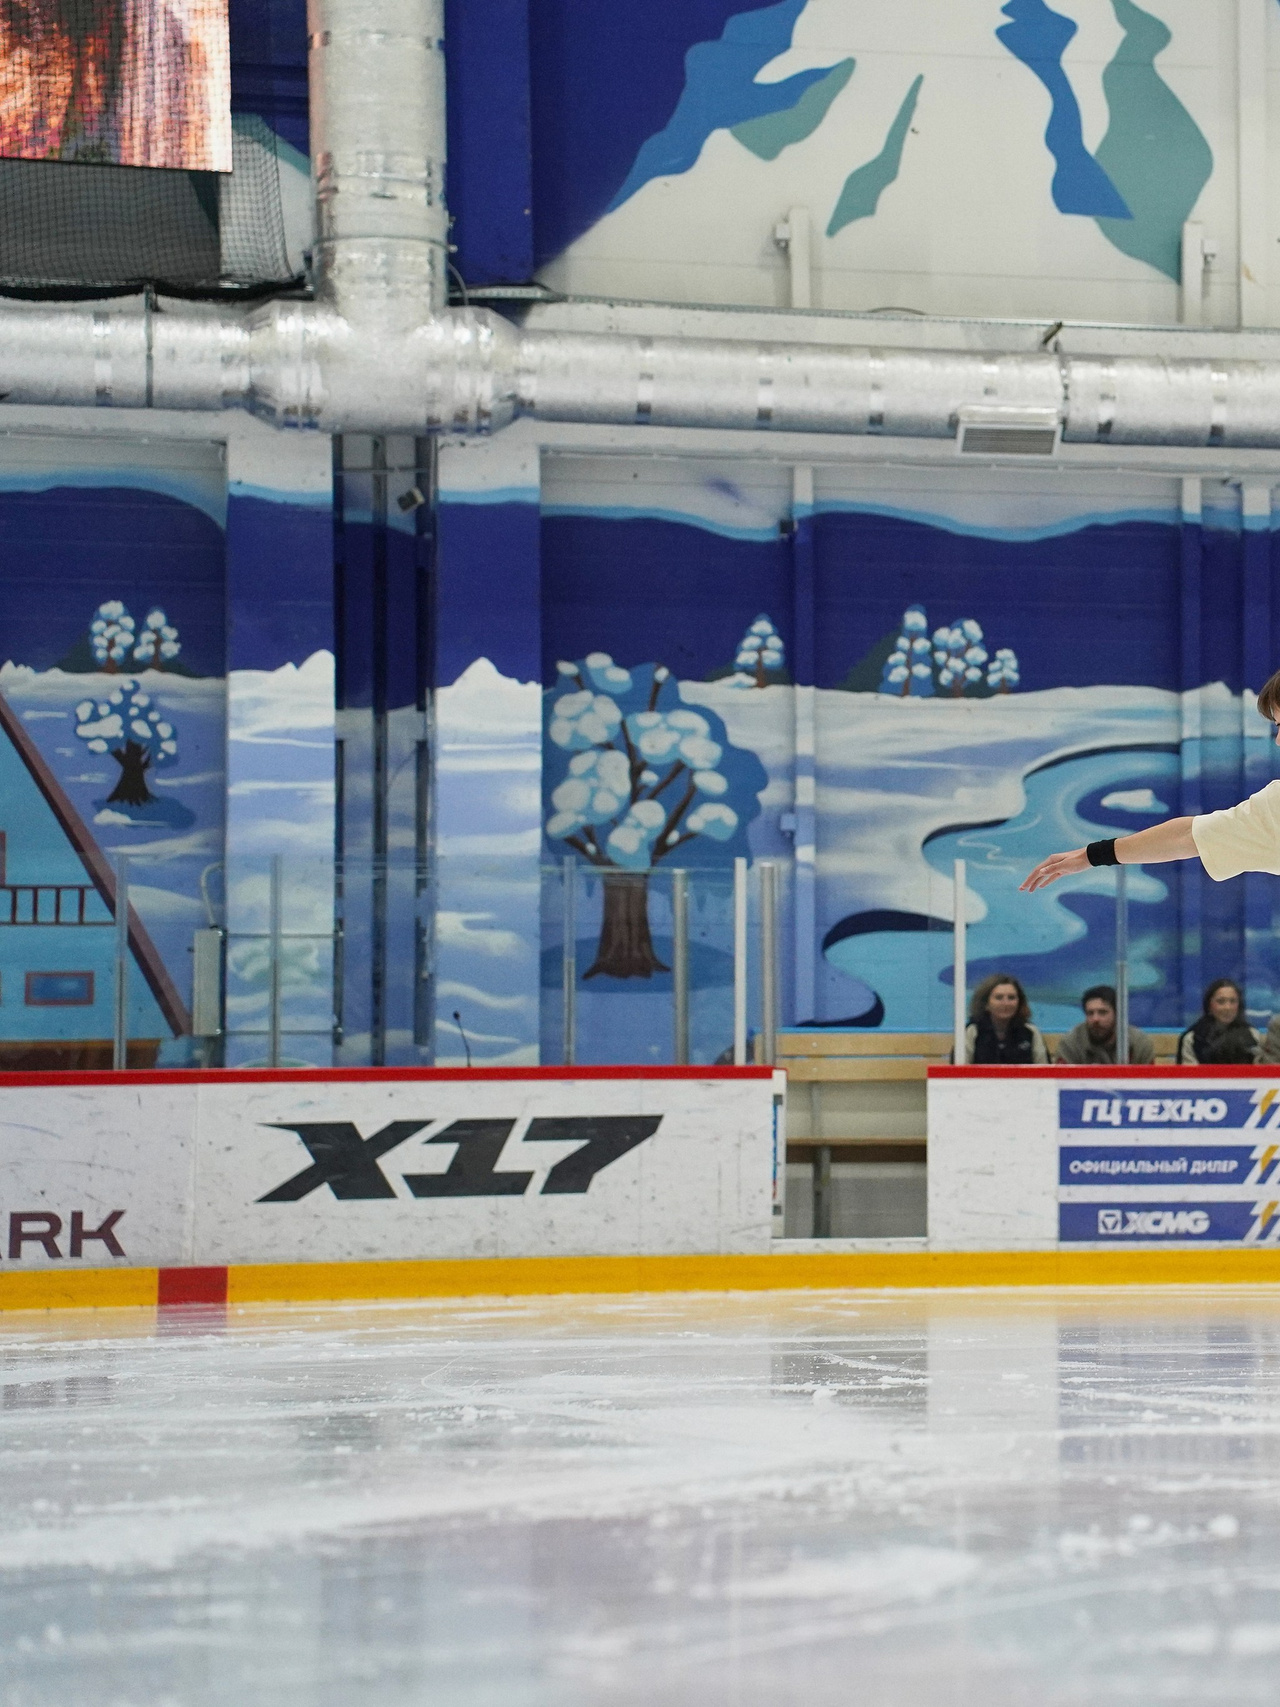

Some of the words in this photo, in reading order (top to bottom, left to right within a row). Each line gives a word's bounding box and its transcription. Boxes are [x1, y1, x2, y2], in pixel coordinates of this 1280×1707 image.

[1127, 1097, 1228, 1122] ТЕХНО
[252, 1114, 664, 1203] X17
[1069, 1157, 1188, 1175] ОФИЦИАЛЬНЫЙ
[1190, 1160, 1239, 1175] ДИЛЕР
[0, 1210, 126, 1259] RK
[1121, 1211, 1210, 1235] XCMG
